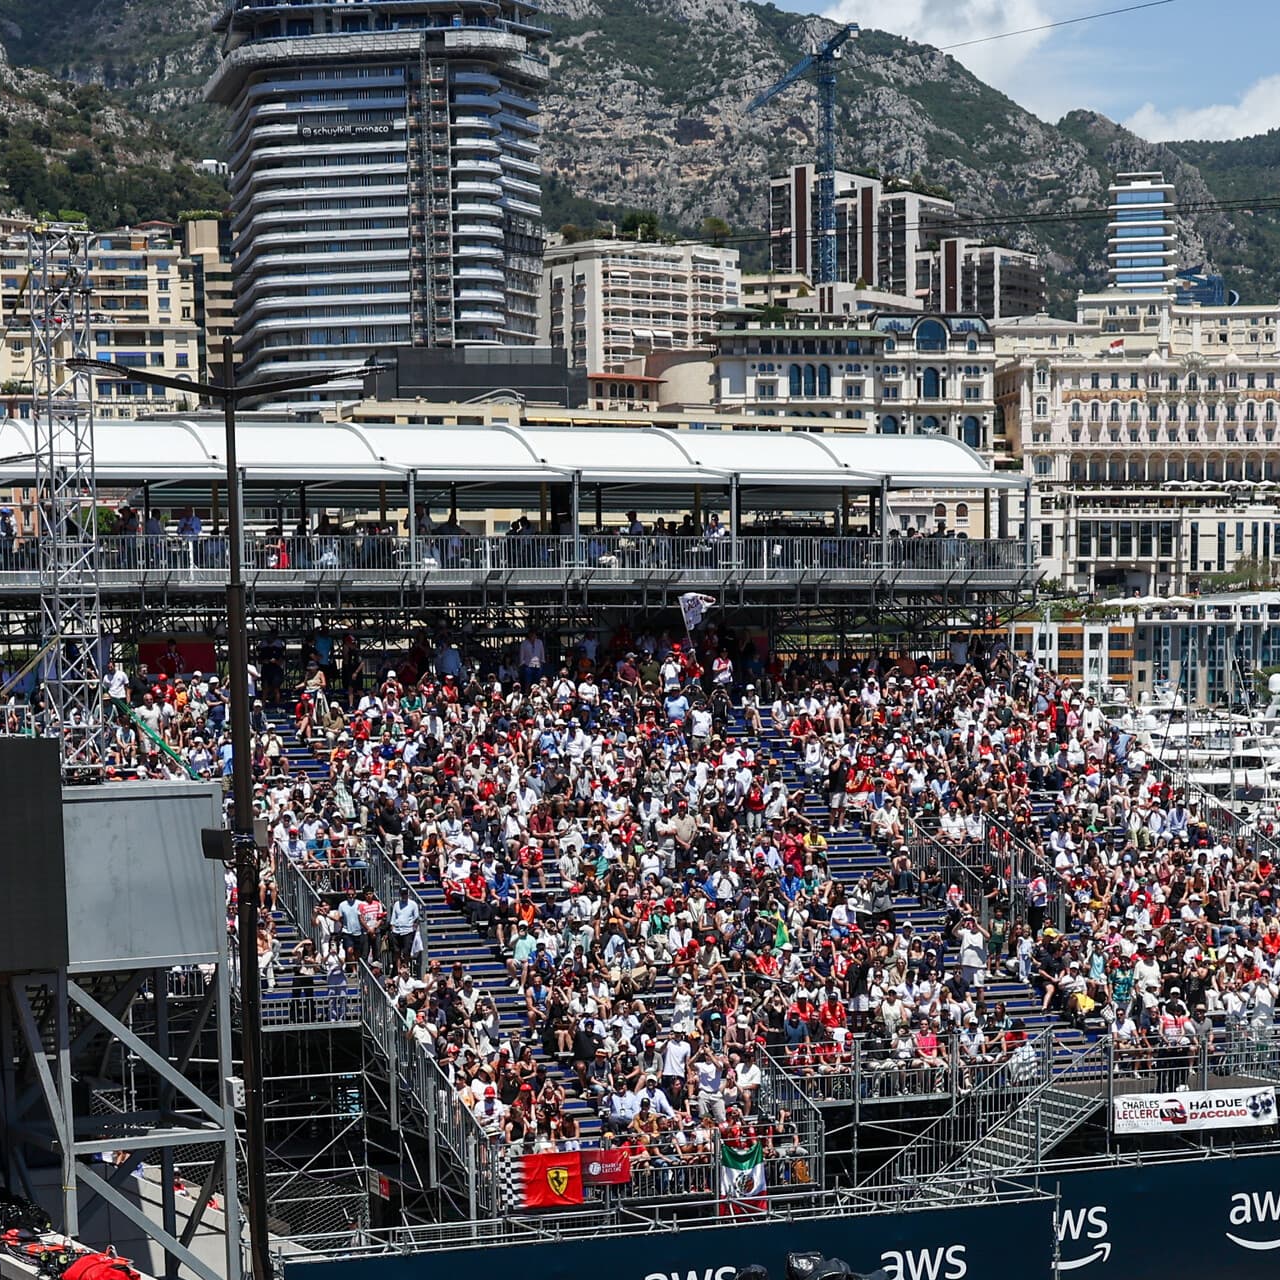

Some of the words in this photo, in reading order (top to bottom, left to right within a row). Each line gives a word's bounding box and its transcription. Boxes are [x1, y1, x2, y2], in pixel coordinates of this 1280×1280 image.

[1122, 1100, 1160, 1110] CHARLES
[1189, 1101, 1213, 1109] HAI
[1215, 1099, 1242, 1108] DUE
[1117, 1108, 1160, 1120] LECLERC
[1057, 1206, 1109, 1242] ws
